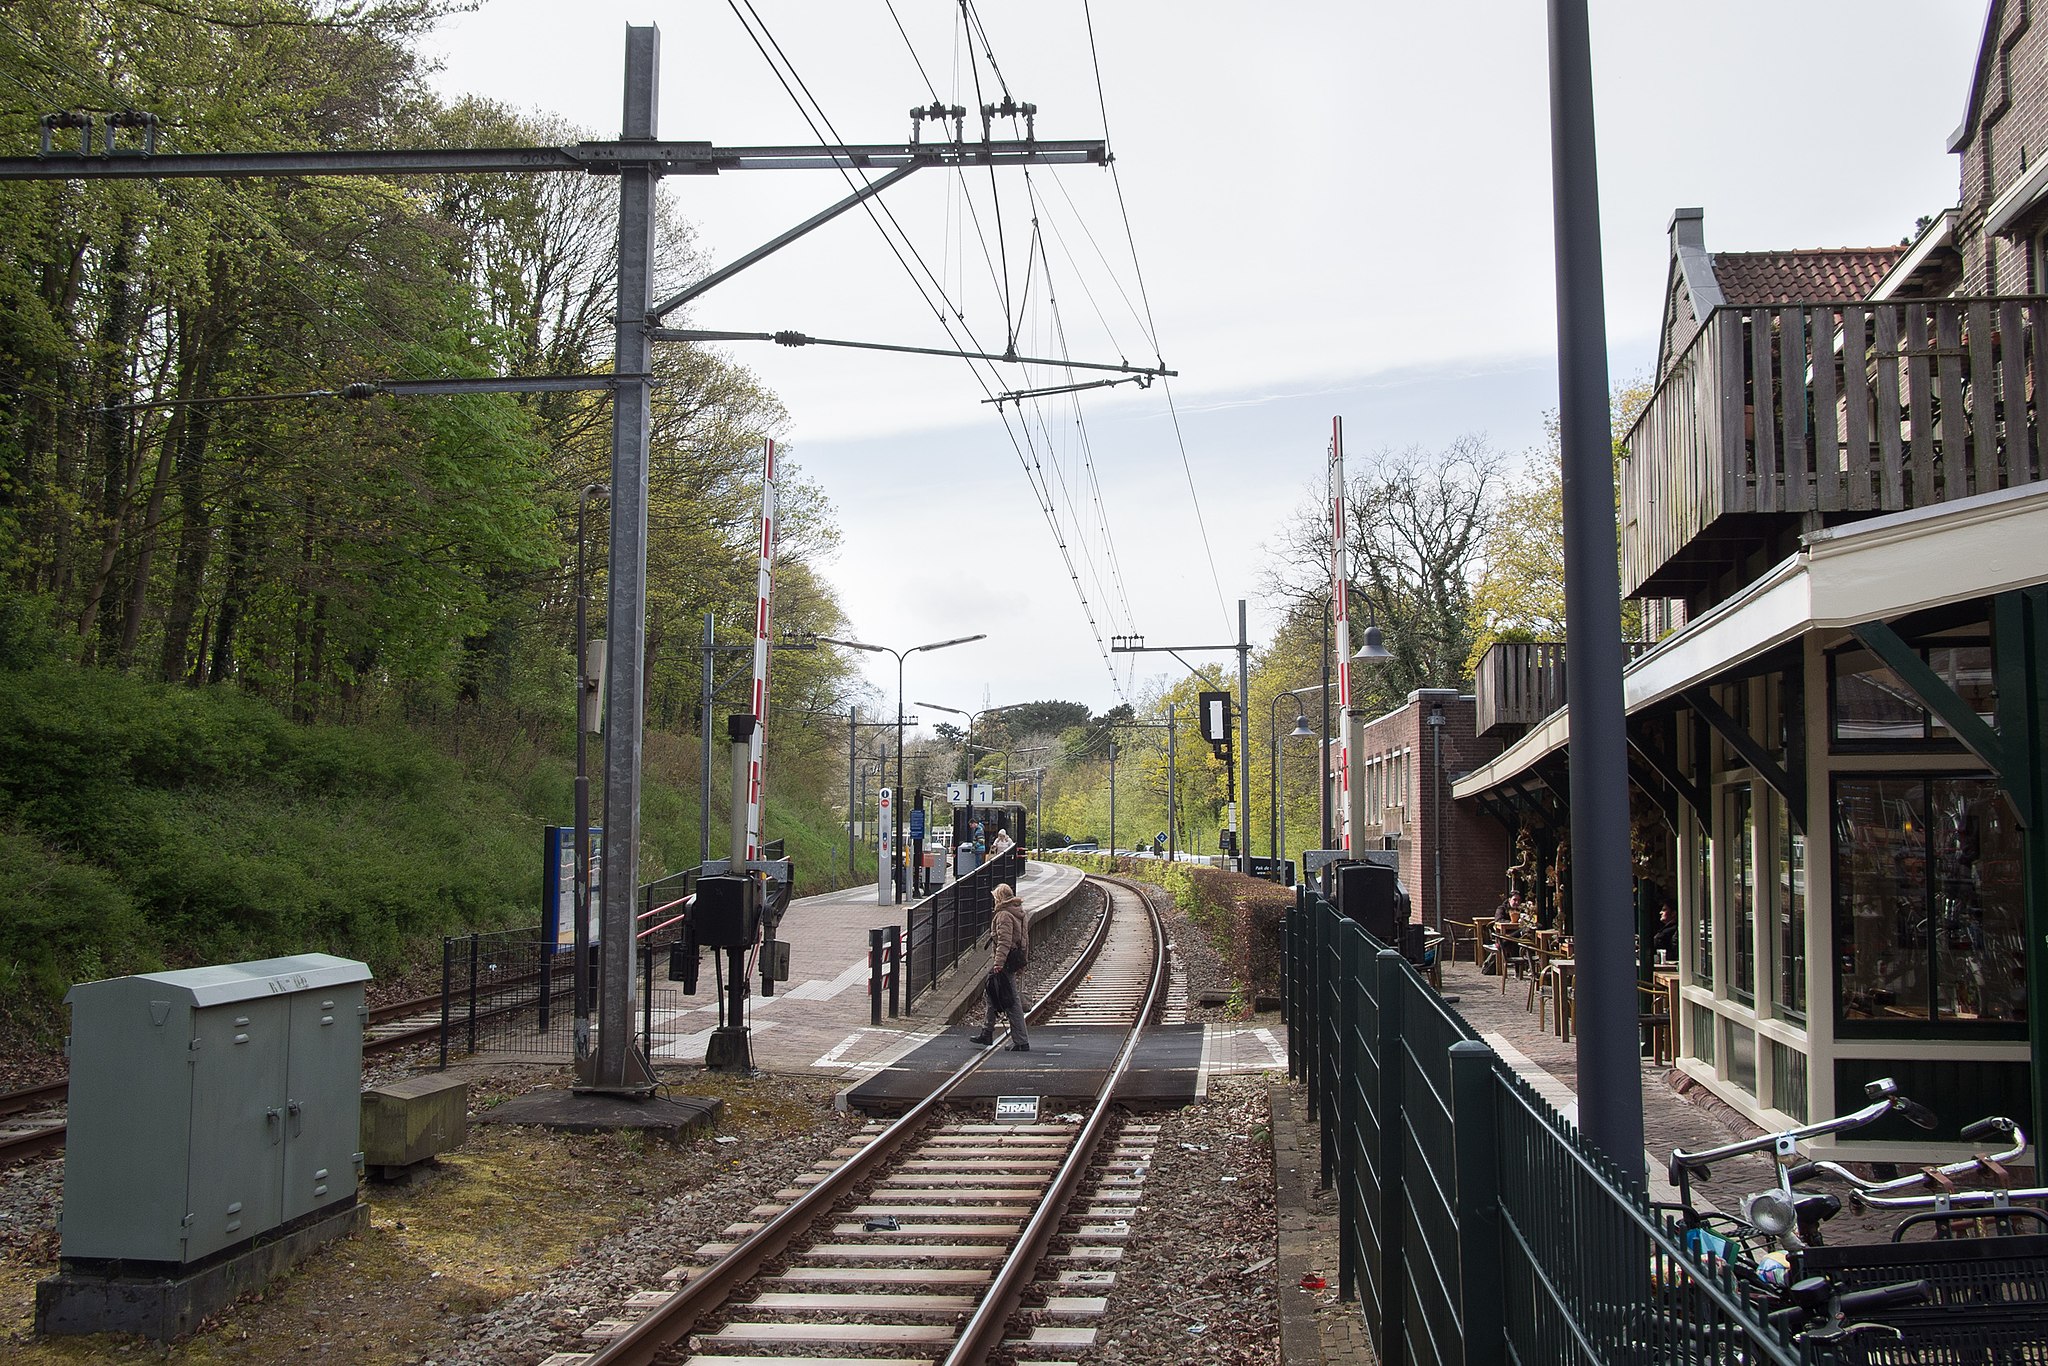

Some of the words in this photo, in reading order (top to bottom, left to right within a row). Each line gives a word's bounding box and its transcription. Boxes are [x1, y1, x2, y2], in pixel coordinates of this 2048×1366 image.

[953, 790, 960, 800] 2
[980, 791, 985, 801] 1
[998, 1103, 1036, 1112] STRAIL
